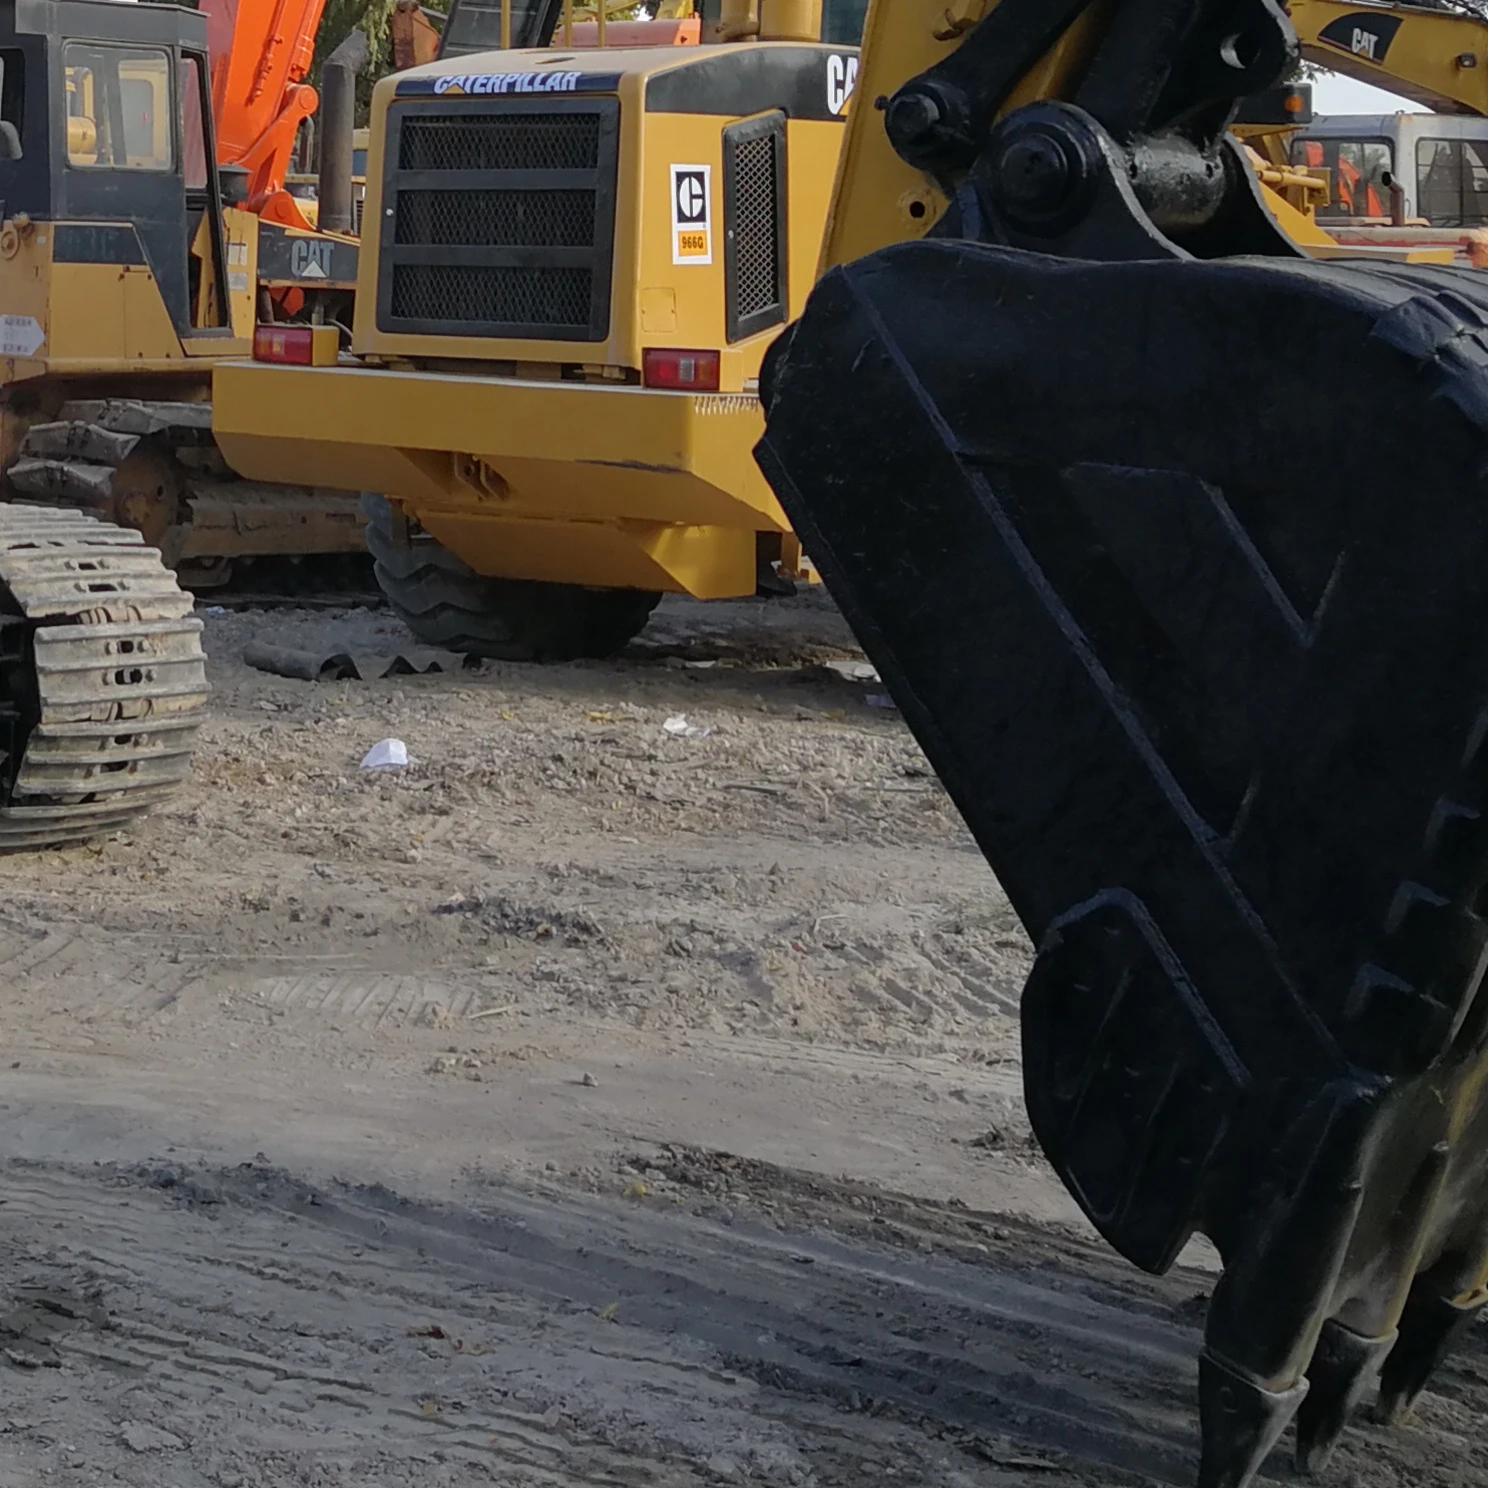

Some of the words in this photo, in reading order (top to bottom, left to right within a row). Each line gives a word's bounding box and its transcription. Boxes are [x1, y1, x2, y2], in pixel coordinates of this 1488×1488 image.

[1352, 27, 1379, 59] CAT
[433, 71, 582, 94] CATERPILLAR
[827, 54, 858, 115] CA
[681, 235, 704, 249] 966G
[292, 240, 334, 277] CAT
